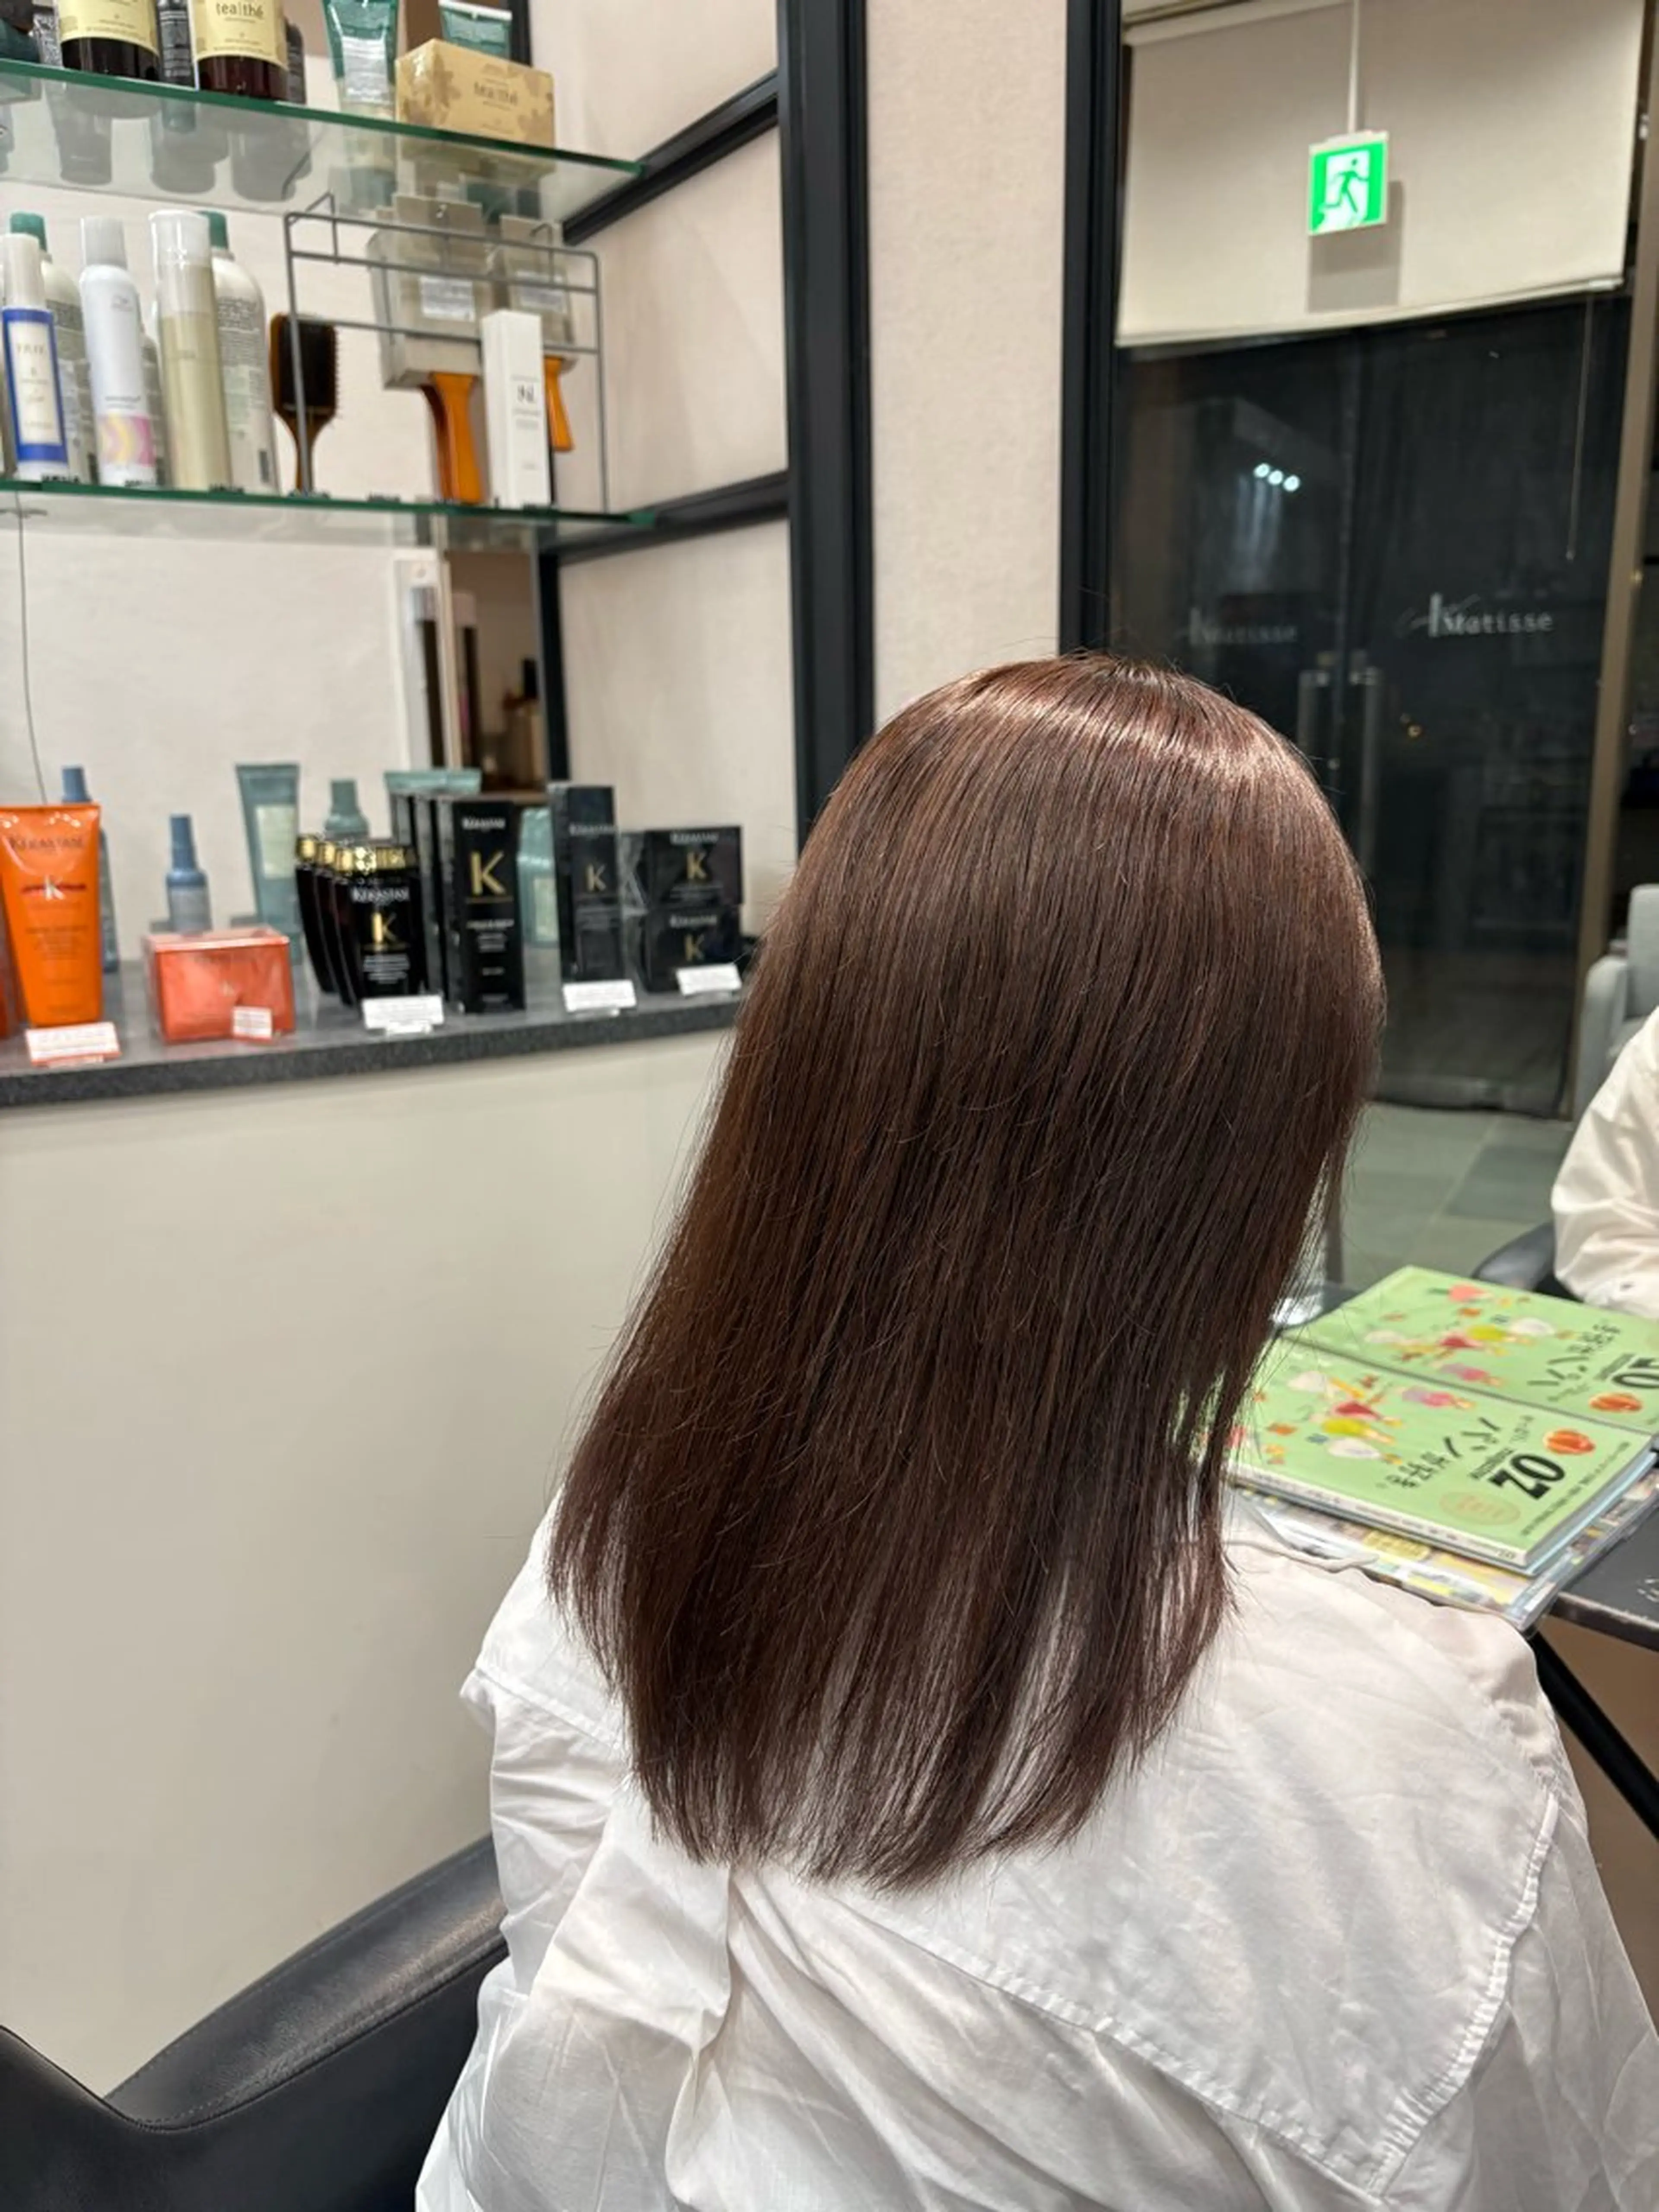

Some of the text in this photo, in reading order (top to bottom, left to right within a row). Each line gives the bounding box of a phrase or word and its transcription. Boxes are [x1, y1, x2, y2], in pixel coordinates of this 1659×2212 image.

[470, 851, 506, 896] K
[586, 864, 606, 892] K
[686, 852, 707, 879] K
[685, 934, 704, 961] K
[1488, 1453, 1566, 1500] OZ
